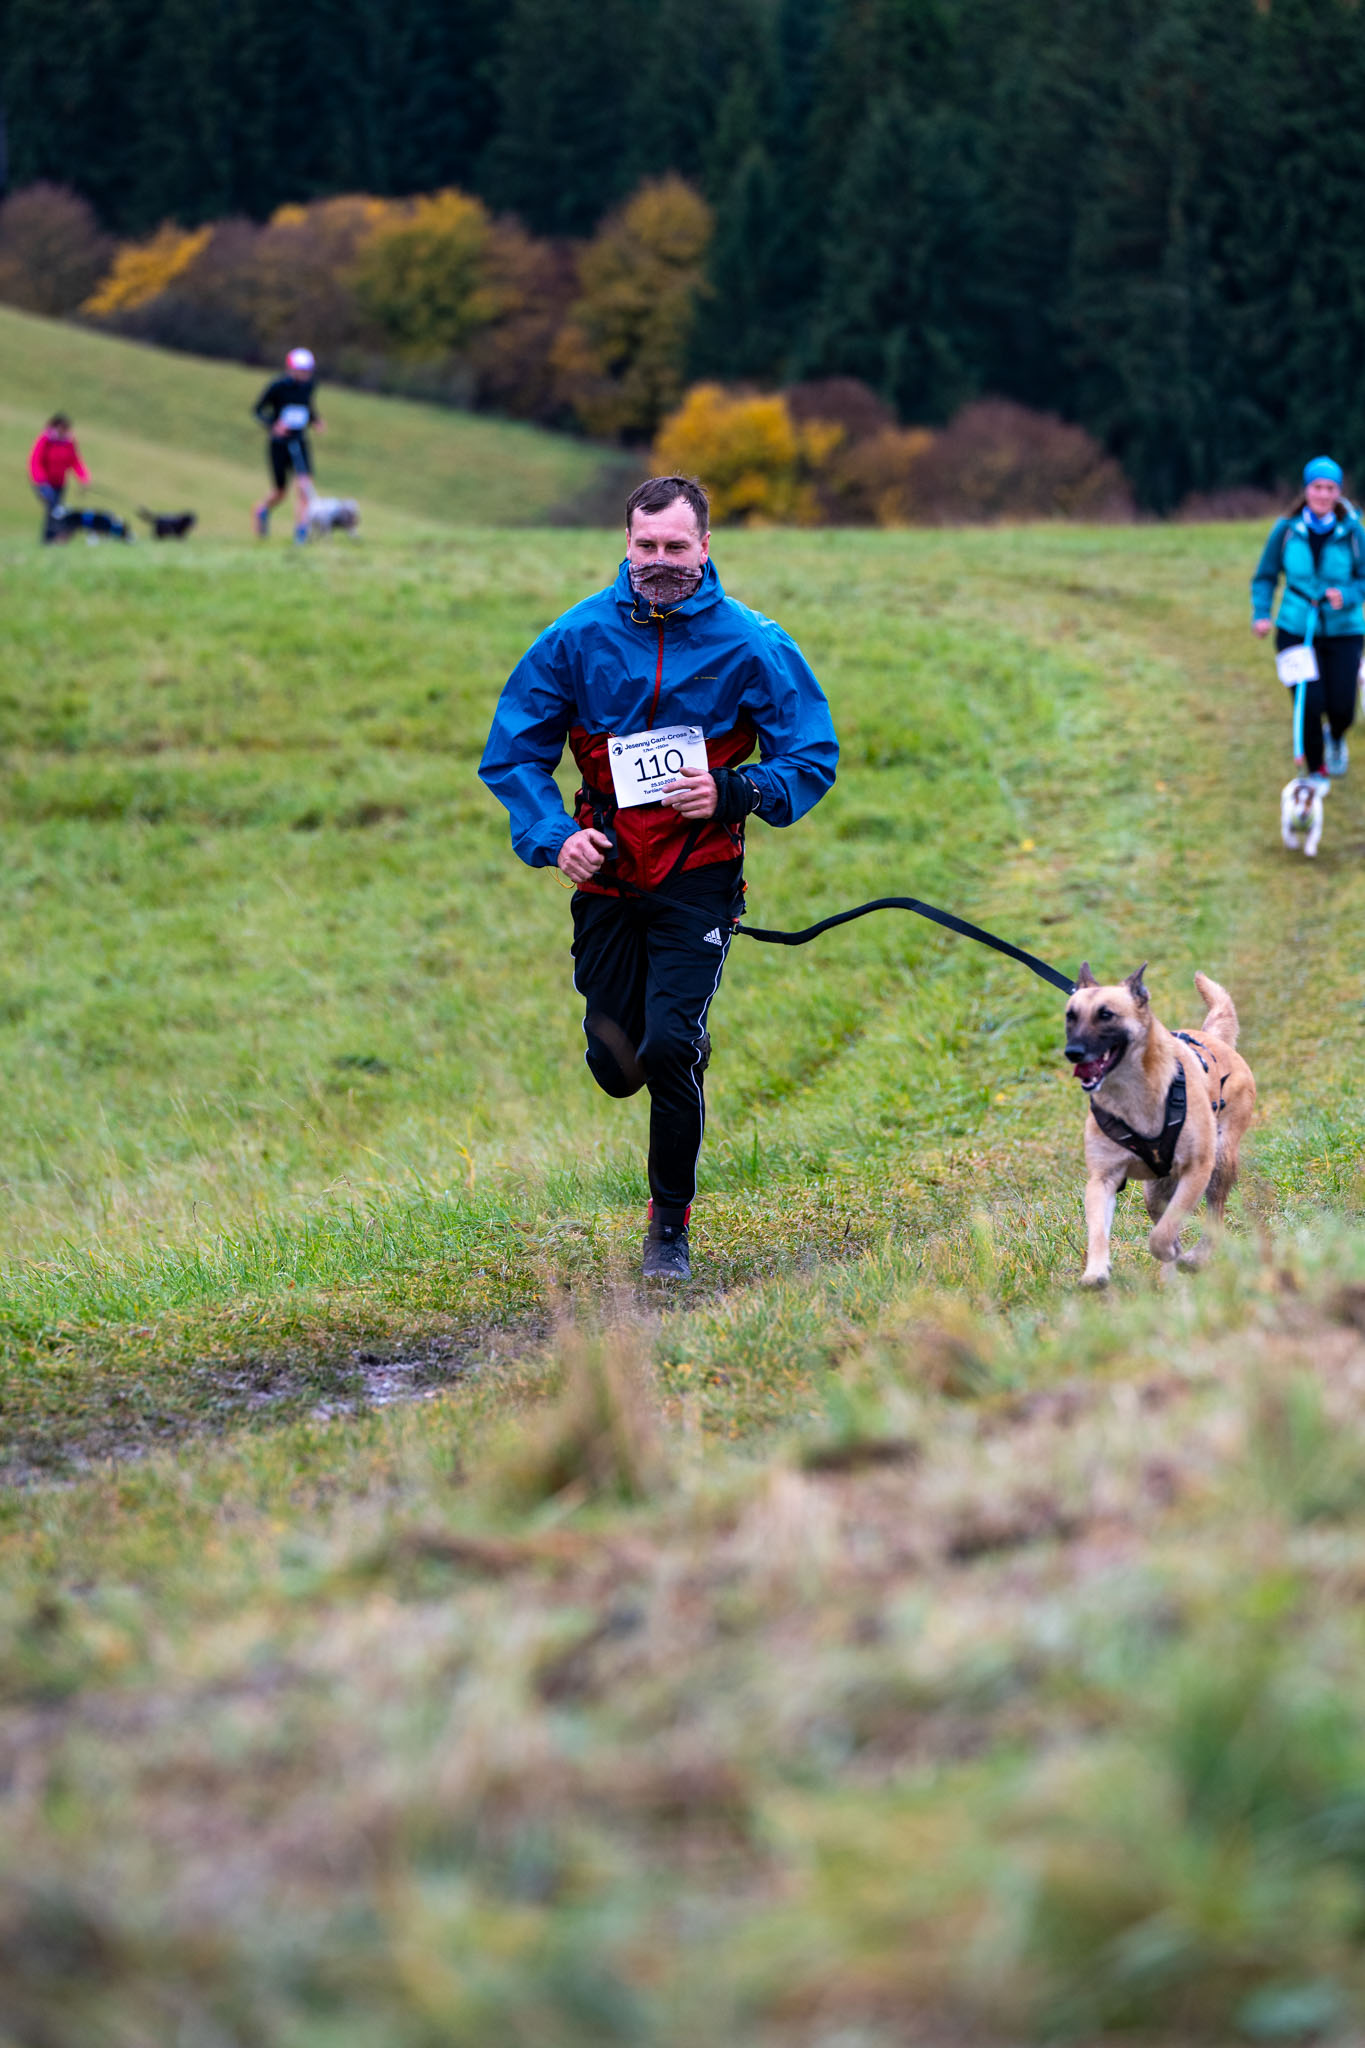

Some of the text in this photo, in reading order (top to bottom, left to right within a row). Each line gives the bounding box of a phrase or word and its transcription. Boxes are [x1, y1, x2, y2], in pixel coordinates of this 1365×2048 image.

[650, 732, 687, 744] Cani-Cross
[634, 749, 684, 782] 110
[703, 936, 722, 947] adidas
